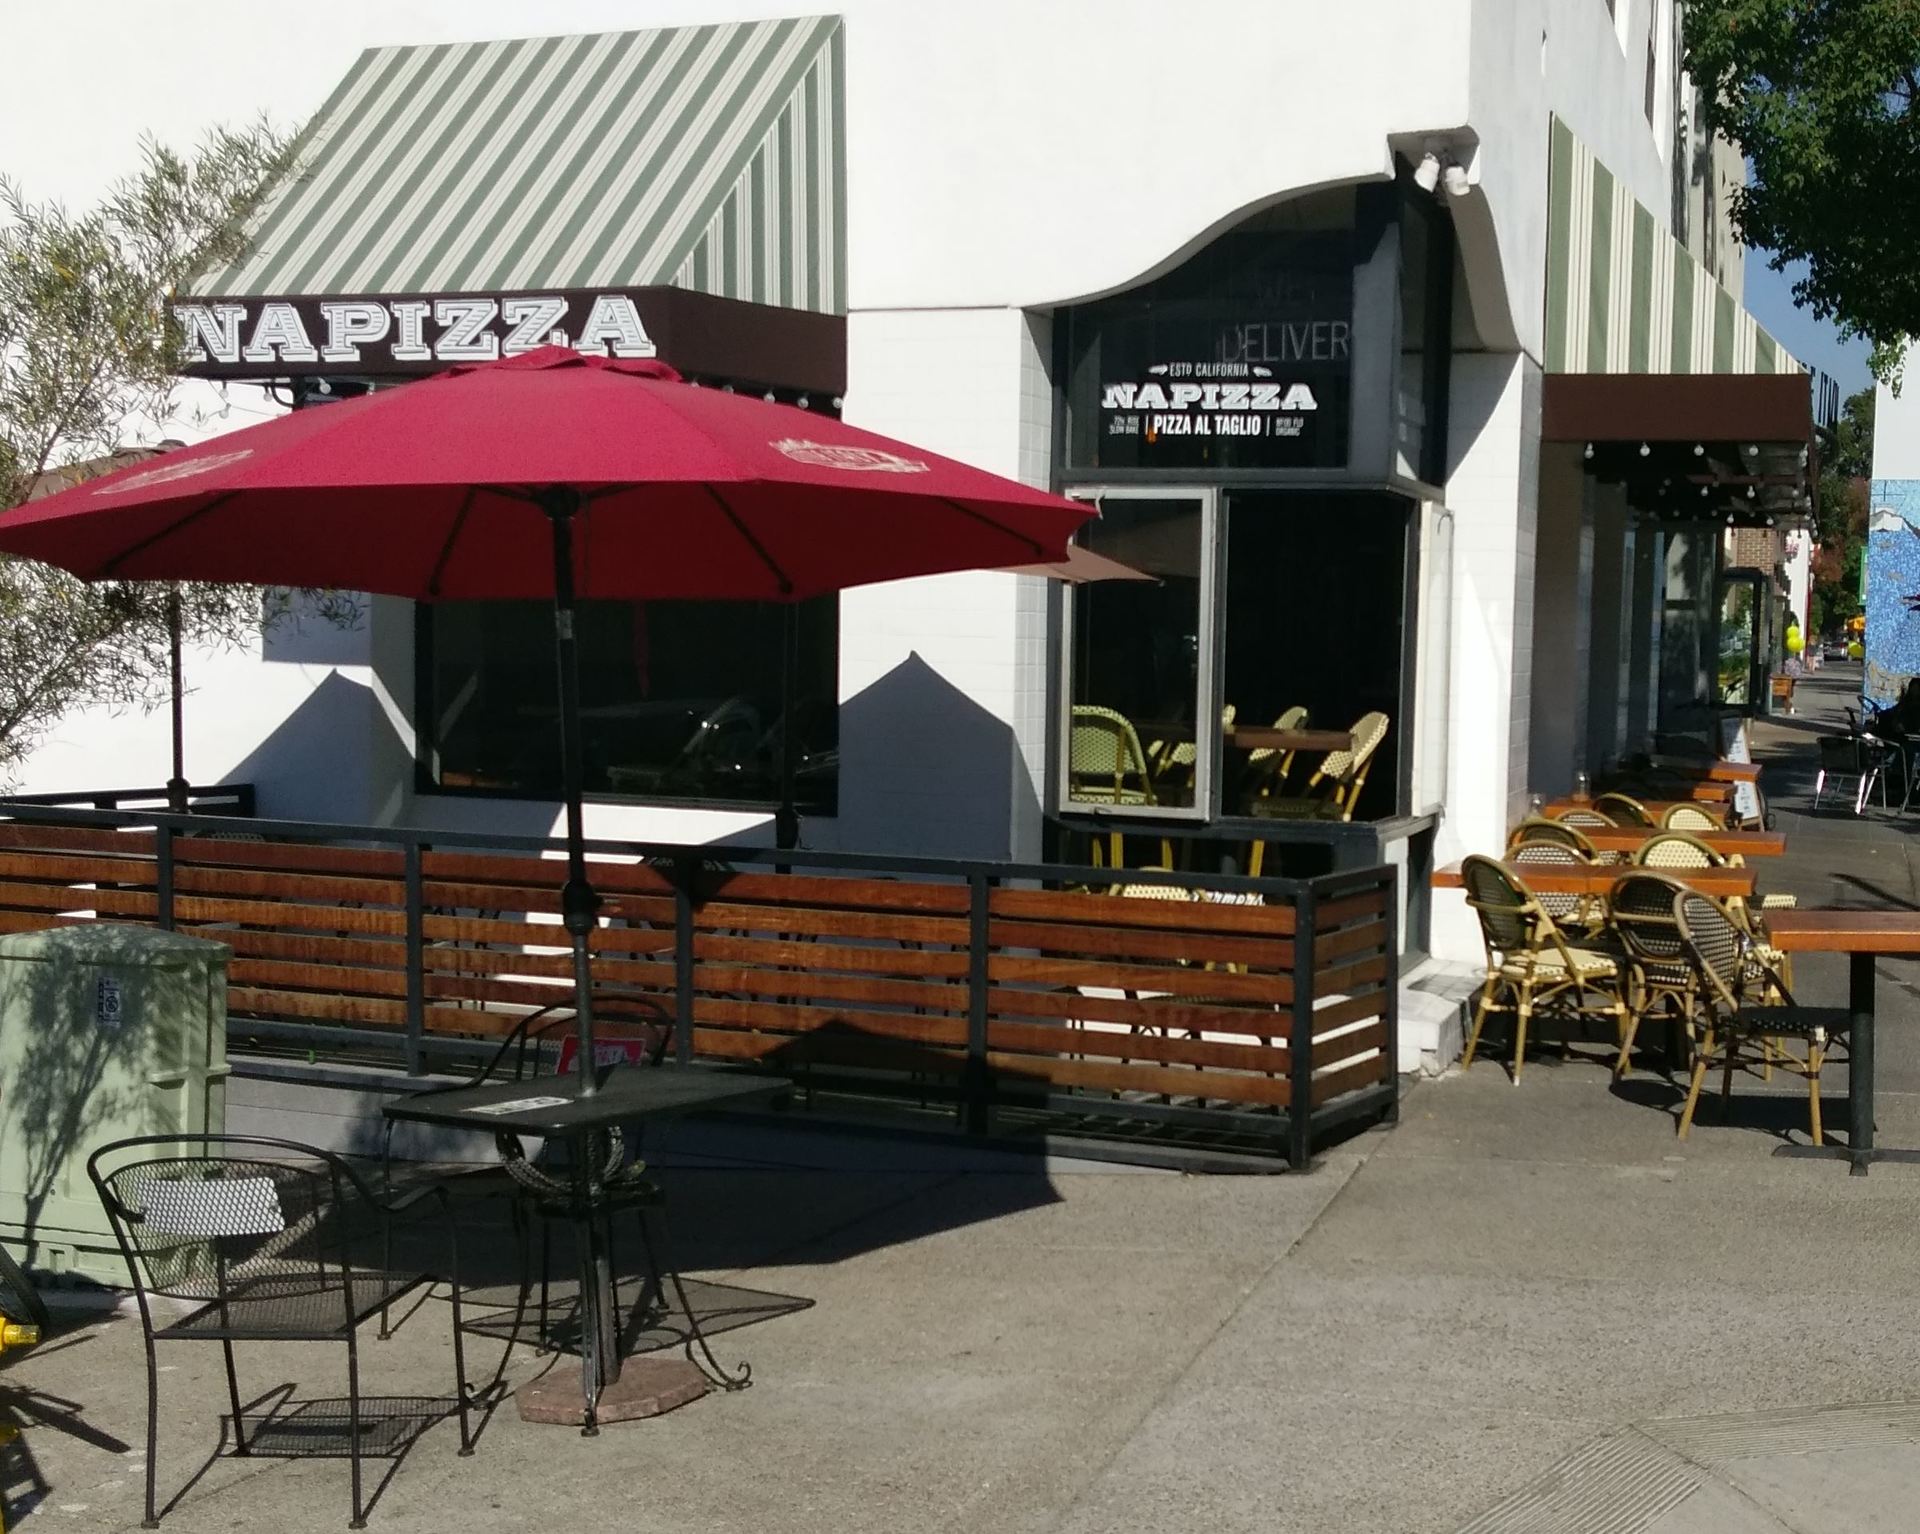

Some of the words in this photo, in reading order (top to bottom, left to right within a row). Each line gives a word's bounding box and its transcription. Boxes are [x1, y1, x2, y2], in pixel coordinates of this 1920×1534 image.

[173, 294, 656, 363] NAPIZZA
[1195, 362, 1249, 377] CALIFORNIA
[1102, 383, 1318, 410] NAPIZZA
[1153, 414, 1191, 435] PIZZA
[1194, 415, 1211, 435] AL
[1216, 415, 1261, 436] TAGLIO
